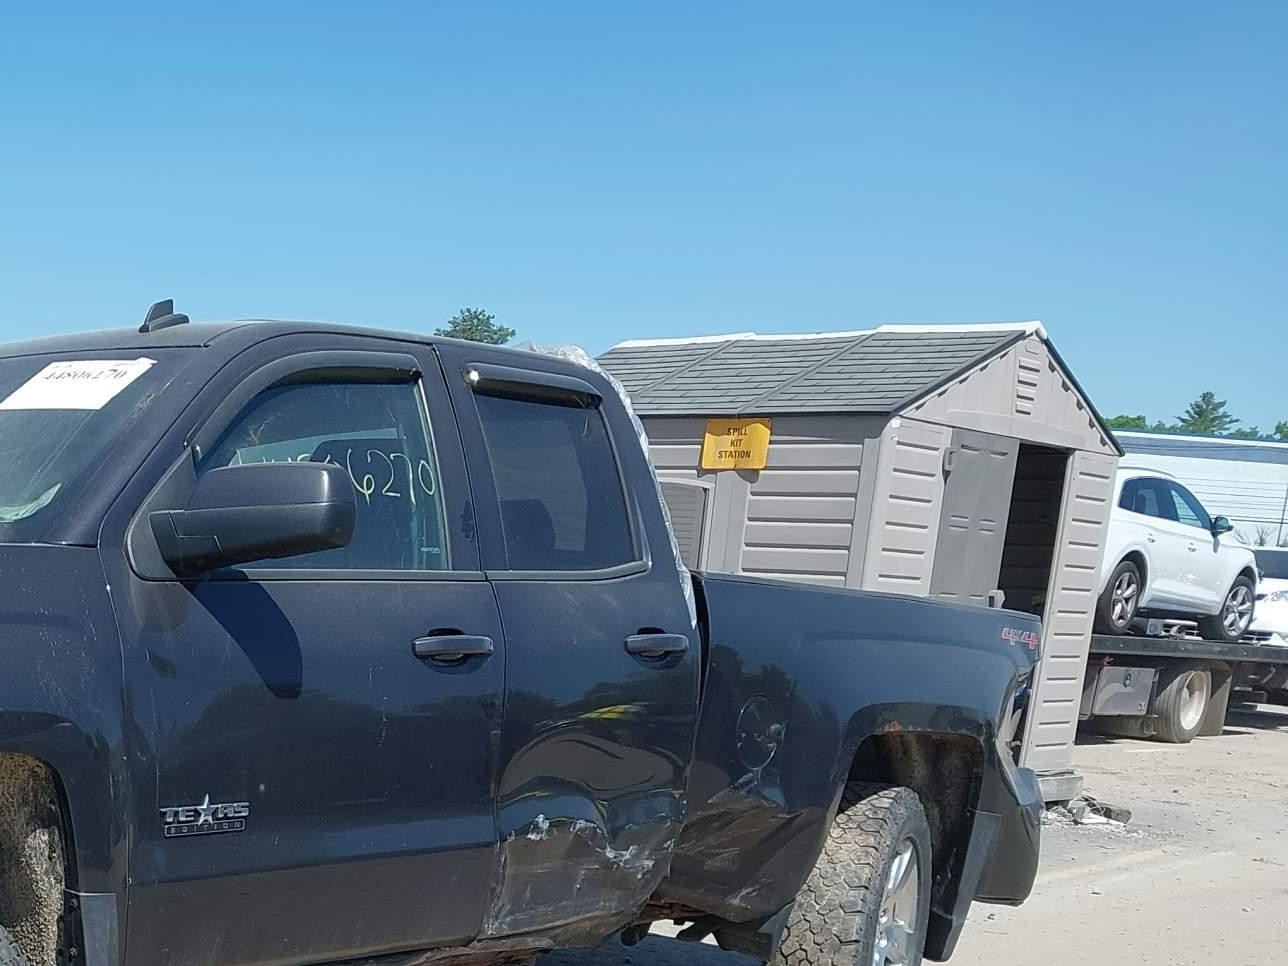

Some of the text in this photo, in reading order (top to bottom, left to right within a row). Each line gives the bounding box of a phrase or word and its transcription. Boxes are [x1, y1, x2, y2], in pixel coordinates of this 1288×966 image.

[726, 426, 748, 437] SPILL
[729, 438, 744, 448] KIT
[717, 449, 752, 460] STATION
